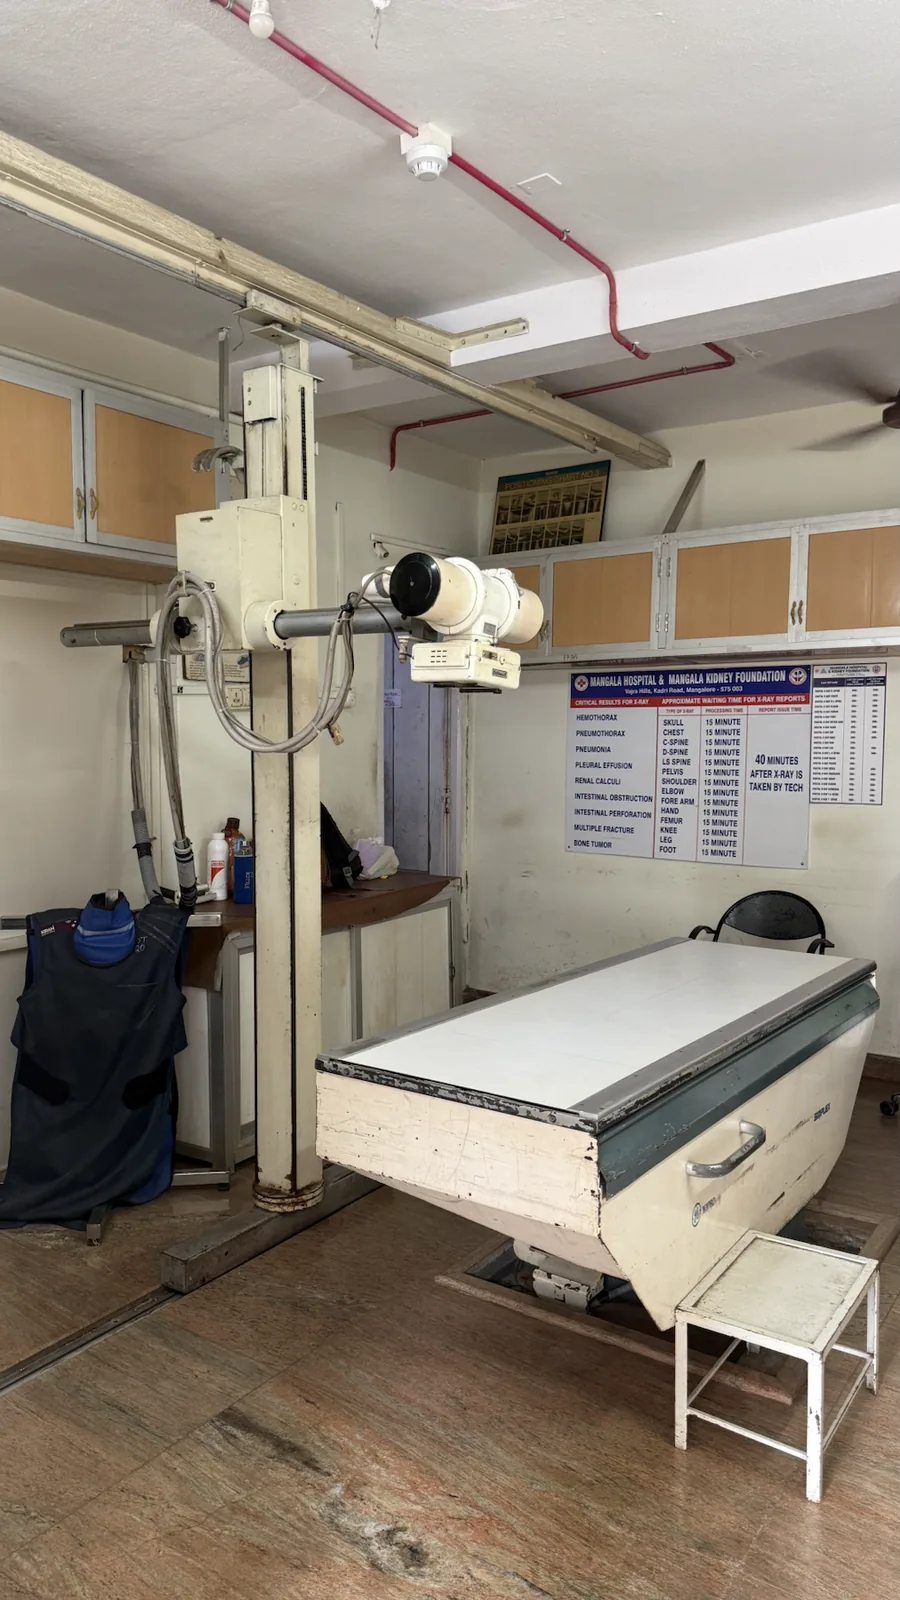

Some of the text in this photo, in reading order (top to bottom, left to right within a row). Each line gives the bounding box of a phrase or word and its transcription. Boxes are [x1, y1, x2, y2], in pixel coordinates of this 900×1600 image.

[590, 670, 786, 687] MANGALA HOSPITAL & MANGALA KIDNEY FOUNDATION
[755, 754, 798, 765] 40 MINUTES
[750, 770, 803, 779] AFTER X-RAY IS
[750, 783, 771, 791] TAKEN
[785, 784, 803, 792] TECH
[609, 794, 653, 802] OBSTRUCTION
[713, 799, 738, 807] MINUTE
[609, 810, 651, 818] PERFORATION
[574, 824, 634, 834] MULTIPLE FRACTURE
[660, 846, 676, 854] FOOT
